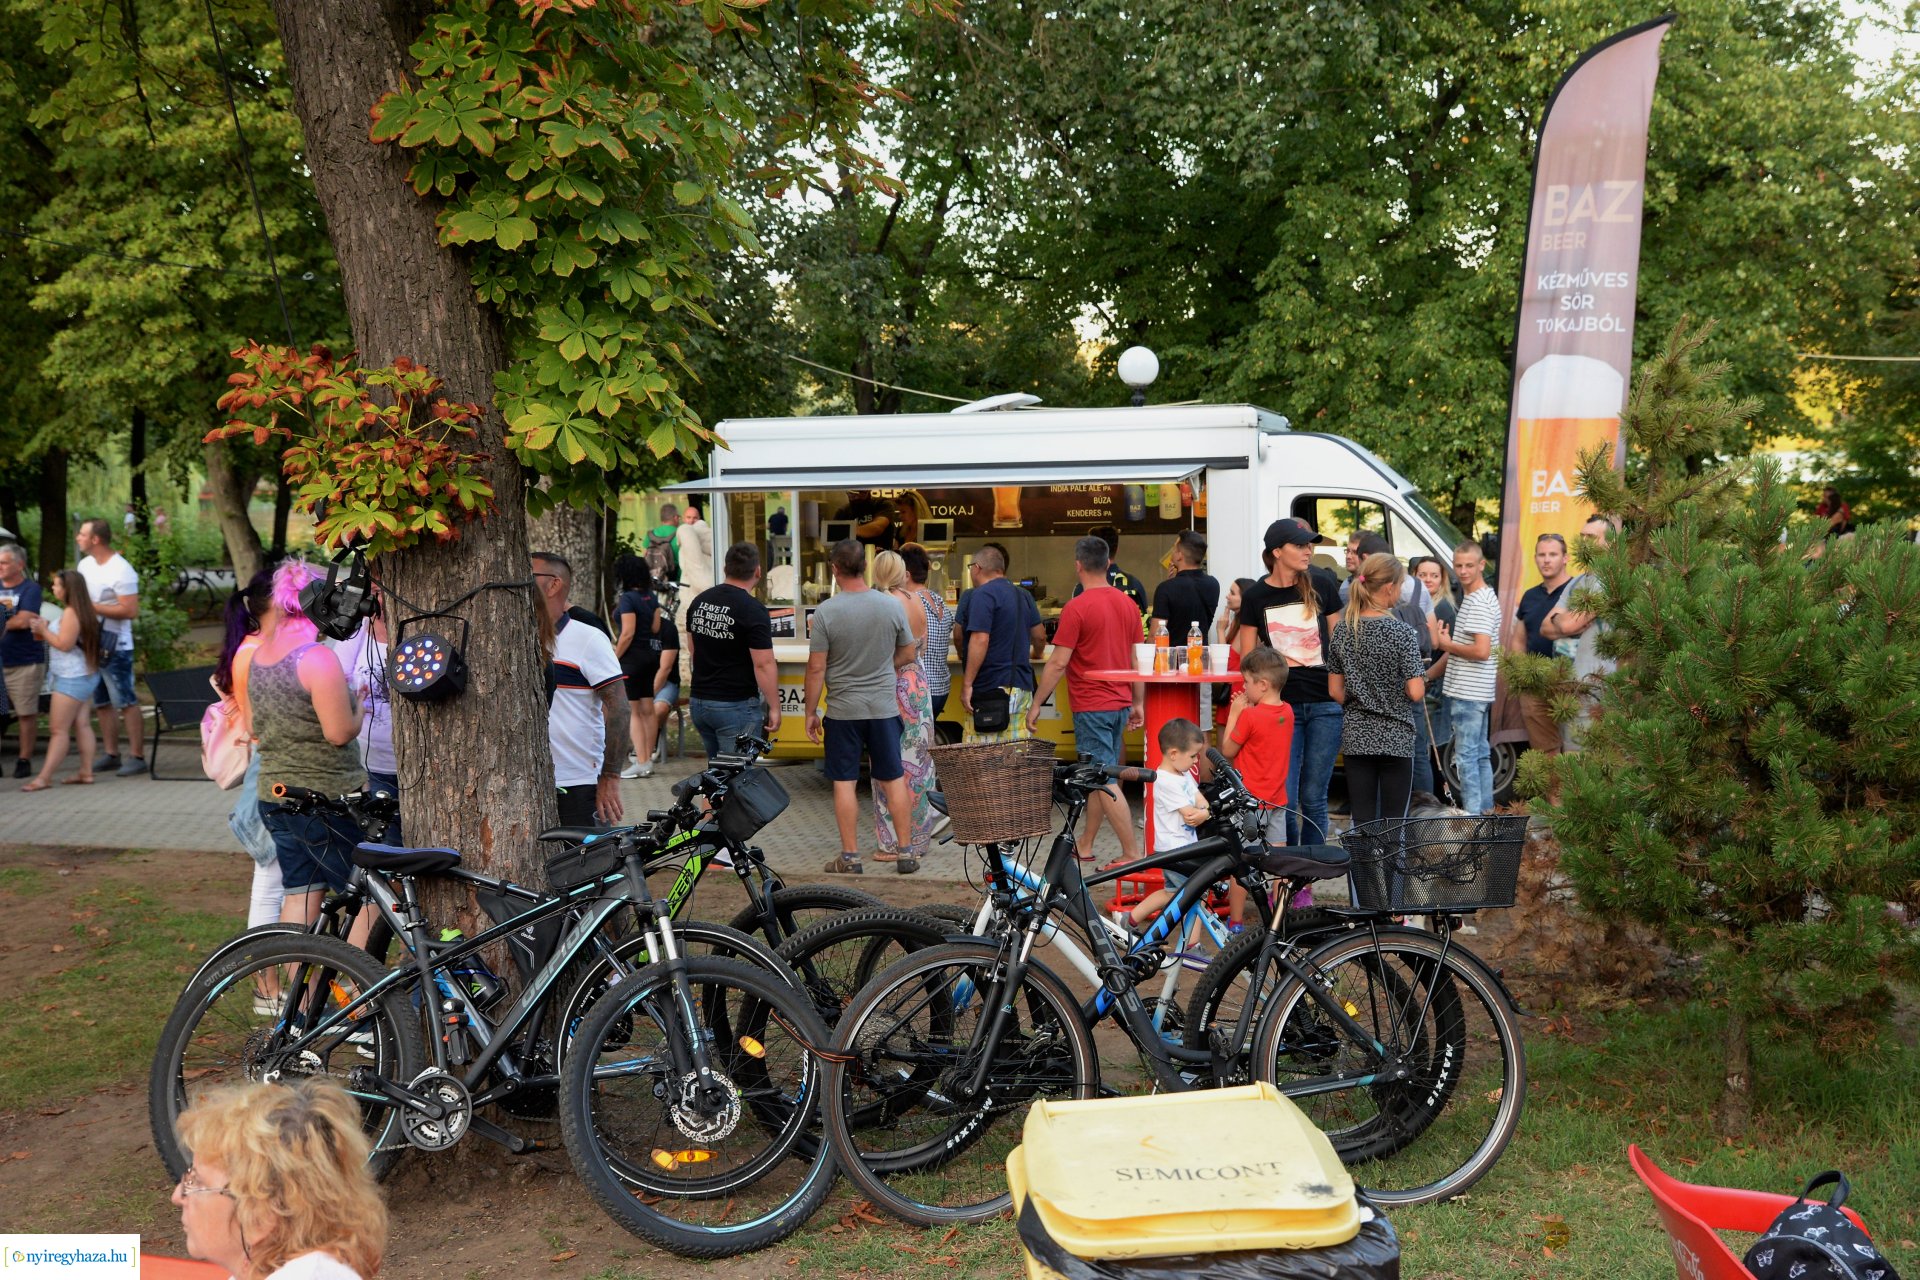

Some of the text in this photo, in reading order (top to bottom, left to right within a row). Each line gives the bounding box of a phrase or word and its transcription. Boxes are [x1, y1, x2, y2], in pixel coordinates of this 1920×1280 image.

[1544, 180, 1637, 226] BAZ
[1541, 231, 1587, 251] BEER
[1536, 313, 1626, 335] TOKAJBÓL
[1050, 484, 1070, 493] INDIA
[1070, 484, 1088, 492] PALE
[1089, 484, 1102, 492] ALE
[930, 505, 974, 516] TOKAJ
[1066, 509, 1102, 517] KENDERES
[699, 602, 731, 614] LEAVE IT
[692, 609, 735, 626] ALL BEHIND
[692, 617, 729, 632] FOR A LIFE
[696, 625, 735, 640] SUNDAYS
[781, 704, 799, 712] EER
[204, 962, 238, 987] CUTLASS
[1426, 1042, 1455, 1107] MAXXIS
[1114, 1161, 1282, 1182] SEMICONT
